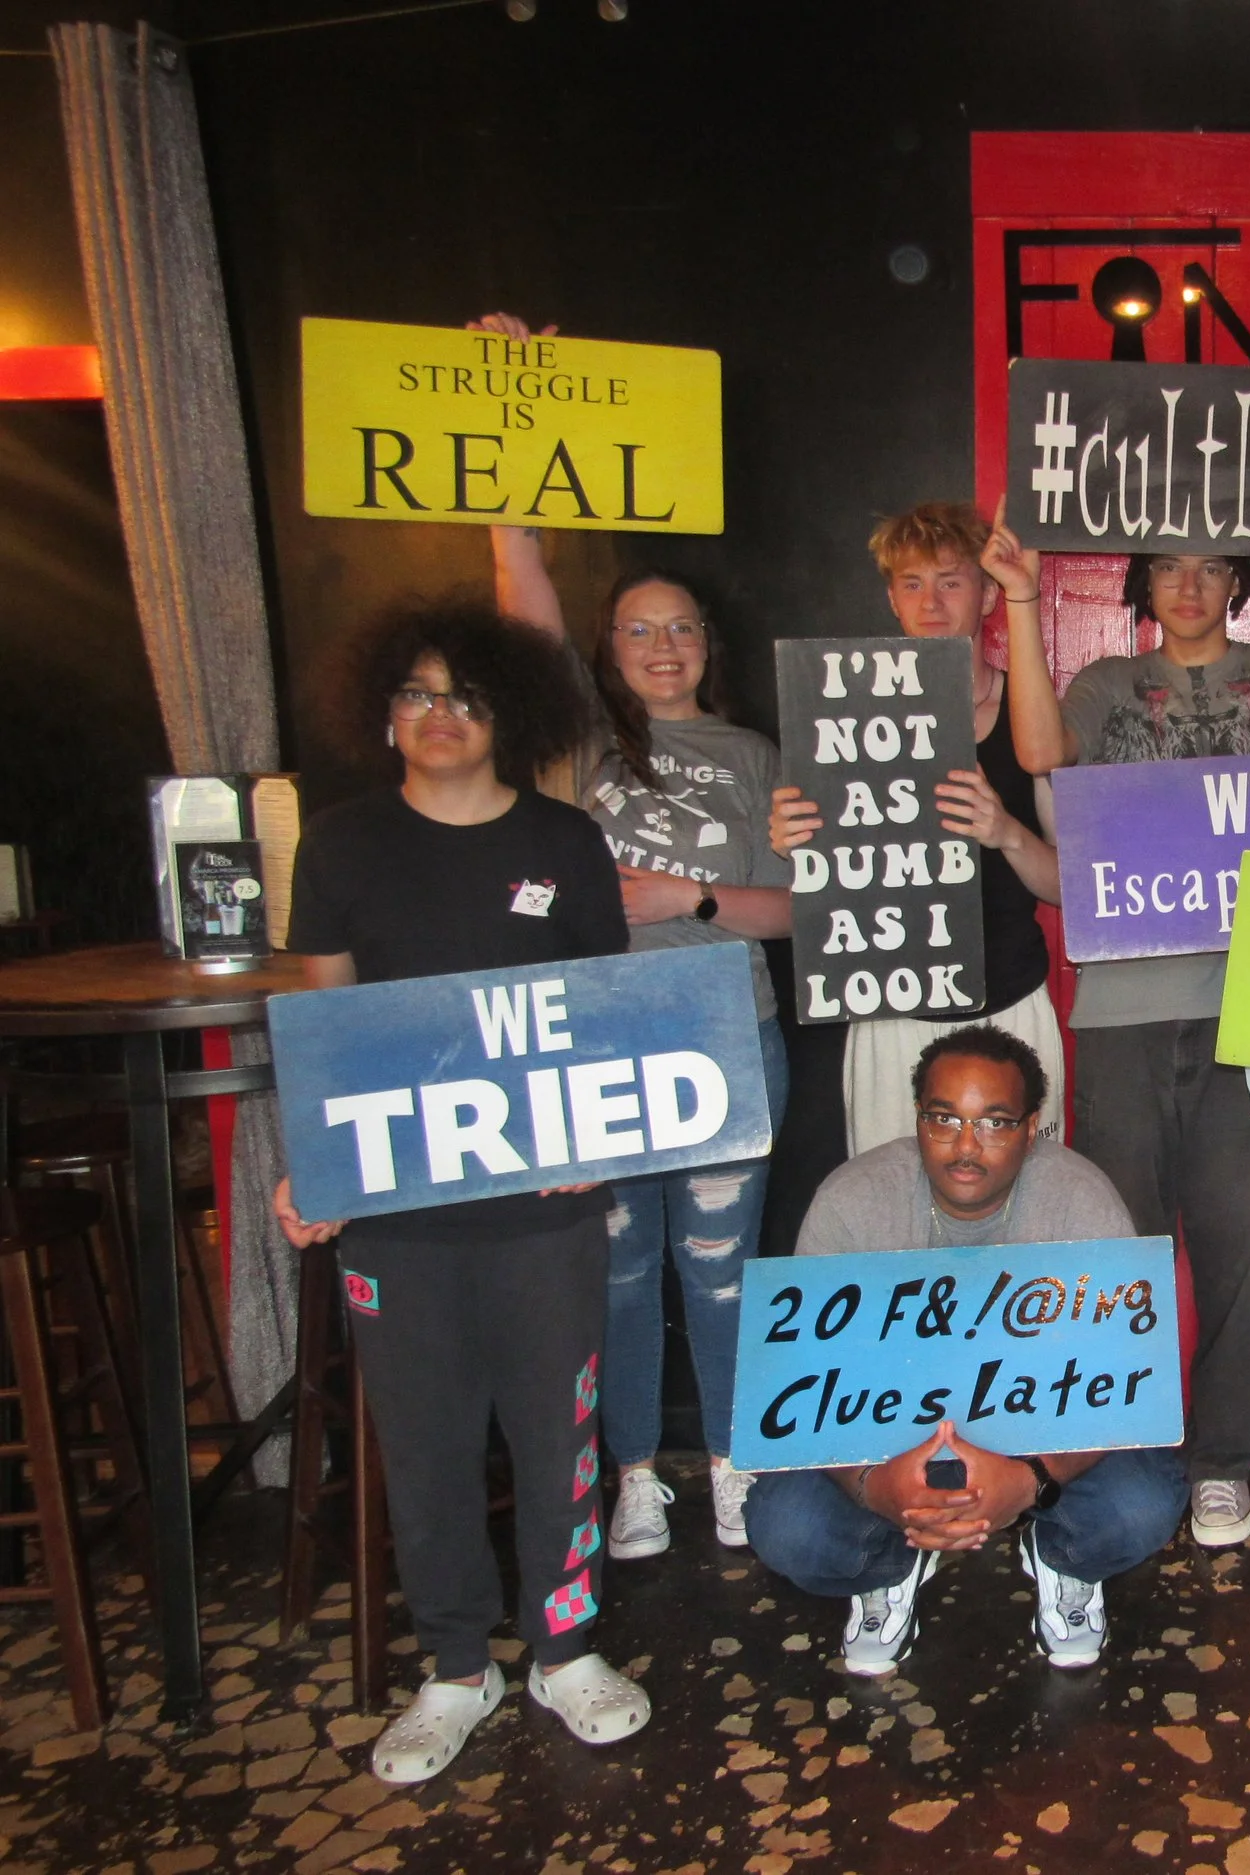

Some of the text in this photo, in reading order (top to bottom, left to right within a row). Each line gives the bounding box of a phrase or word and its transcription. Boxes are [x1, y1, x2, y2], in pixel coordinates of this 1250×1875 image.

[474, 337, 557, 369] THE
[400, 363, 630, 405] STRUGGLE
[501, 402, 535, 430] IS
[352, 427, 676, 522] REAL
[822, 651, 924, 698] I'M
[814, 714, 937, 764] NOT
[838, 779, 921, 827] AS
[790, 840, 976, 893] DUMB
[822, 904, 952, 954] AS I
[806, 964, 973, 1018] LOOK
[472, 979, 573, 1059] WE
[325, 1050, 729, 1194] TRIED
[764, 1283, 862, 1344] 20
[759, 1357, 1153, 1440] Clues Later
